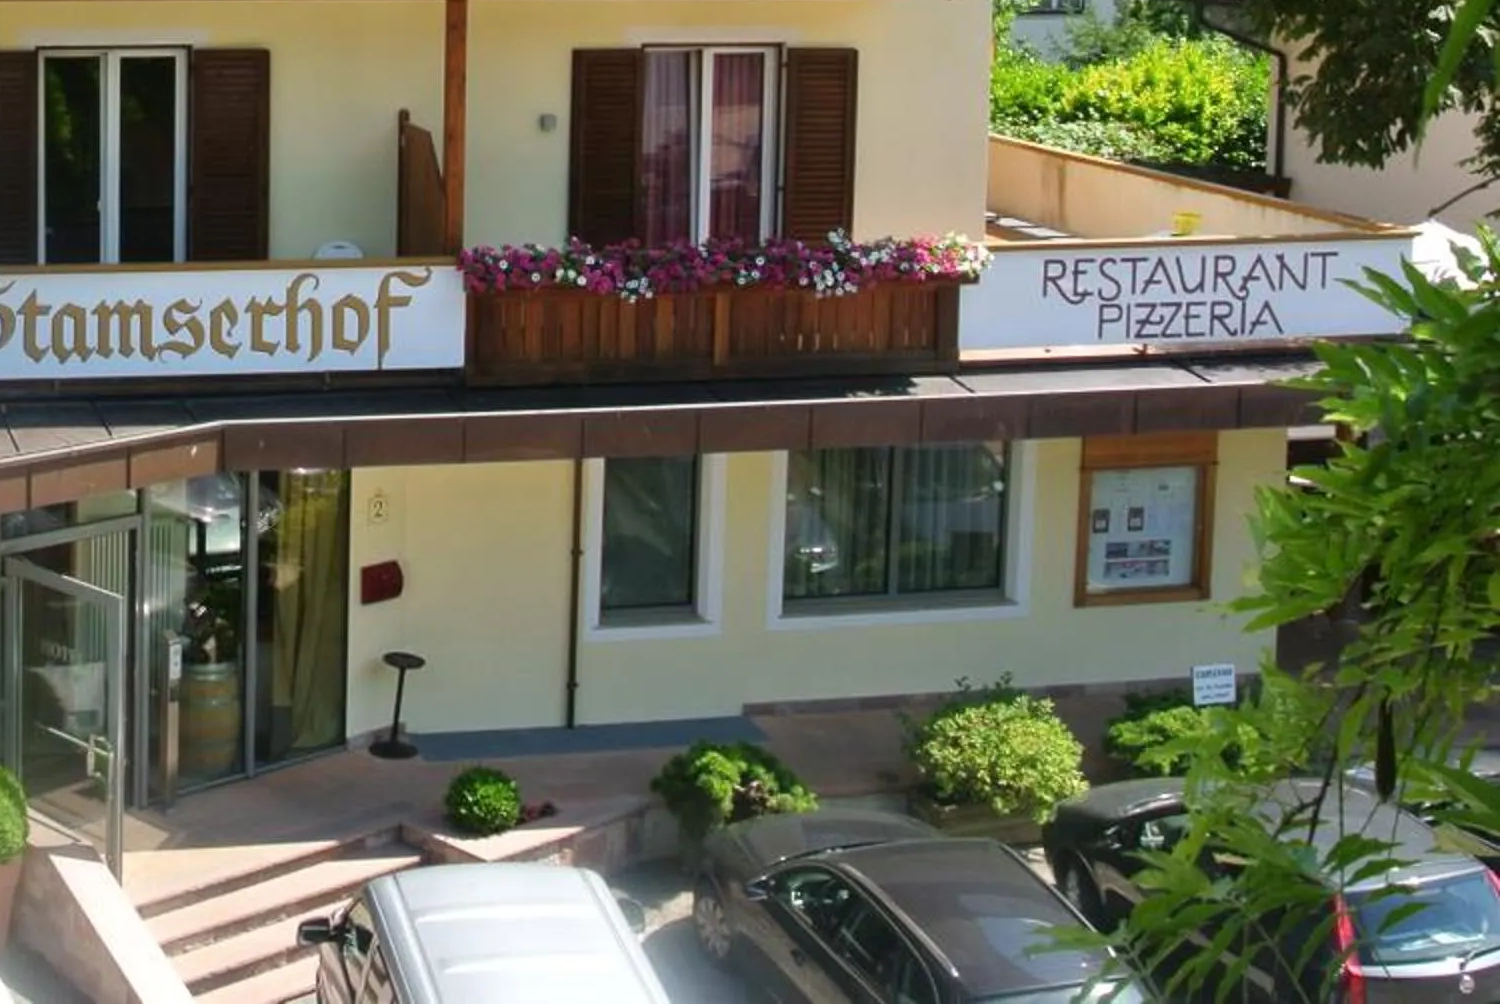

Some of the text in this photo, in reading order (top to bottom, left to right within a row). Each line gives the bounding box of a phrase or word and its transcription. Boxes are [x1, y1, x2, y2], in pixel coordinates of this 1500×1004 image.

[1043, 252, 1339, 306] RESTAURANT
[1098, 299, 1284, 340] PIZZERIA
[372, 499, 384, 519] 2
